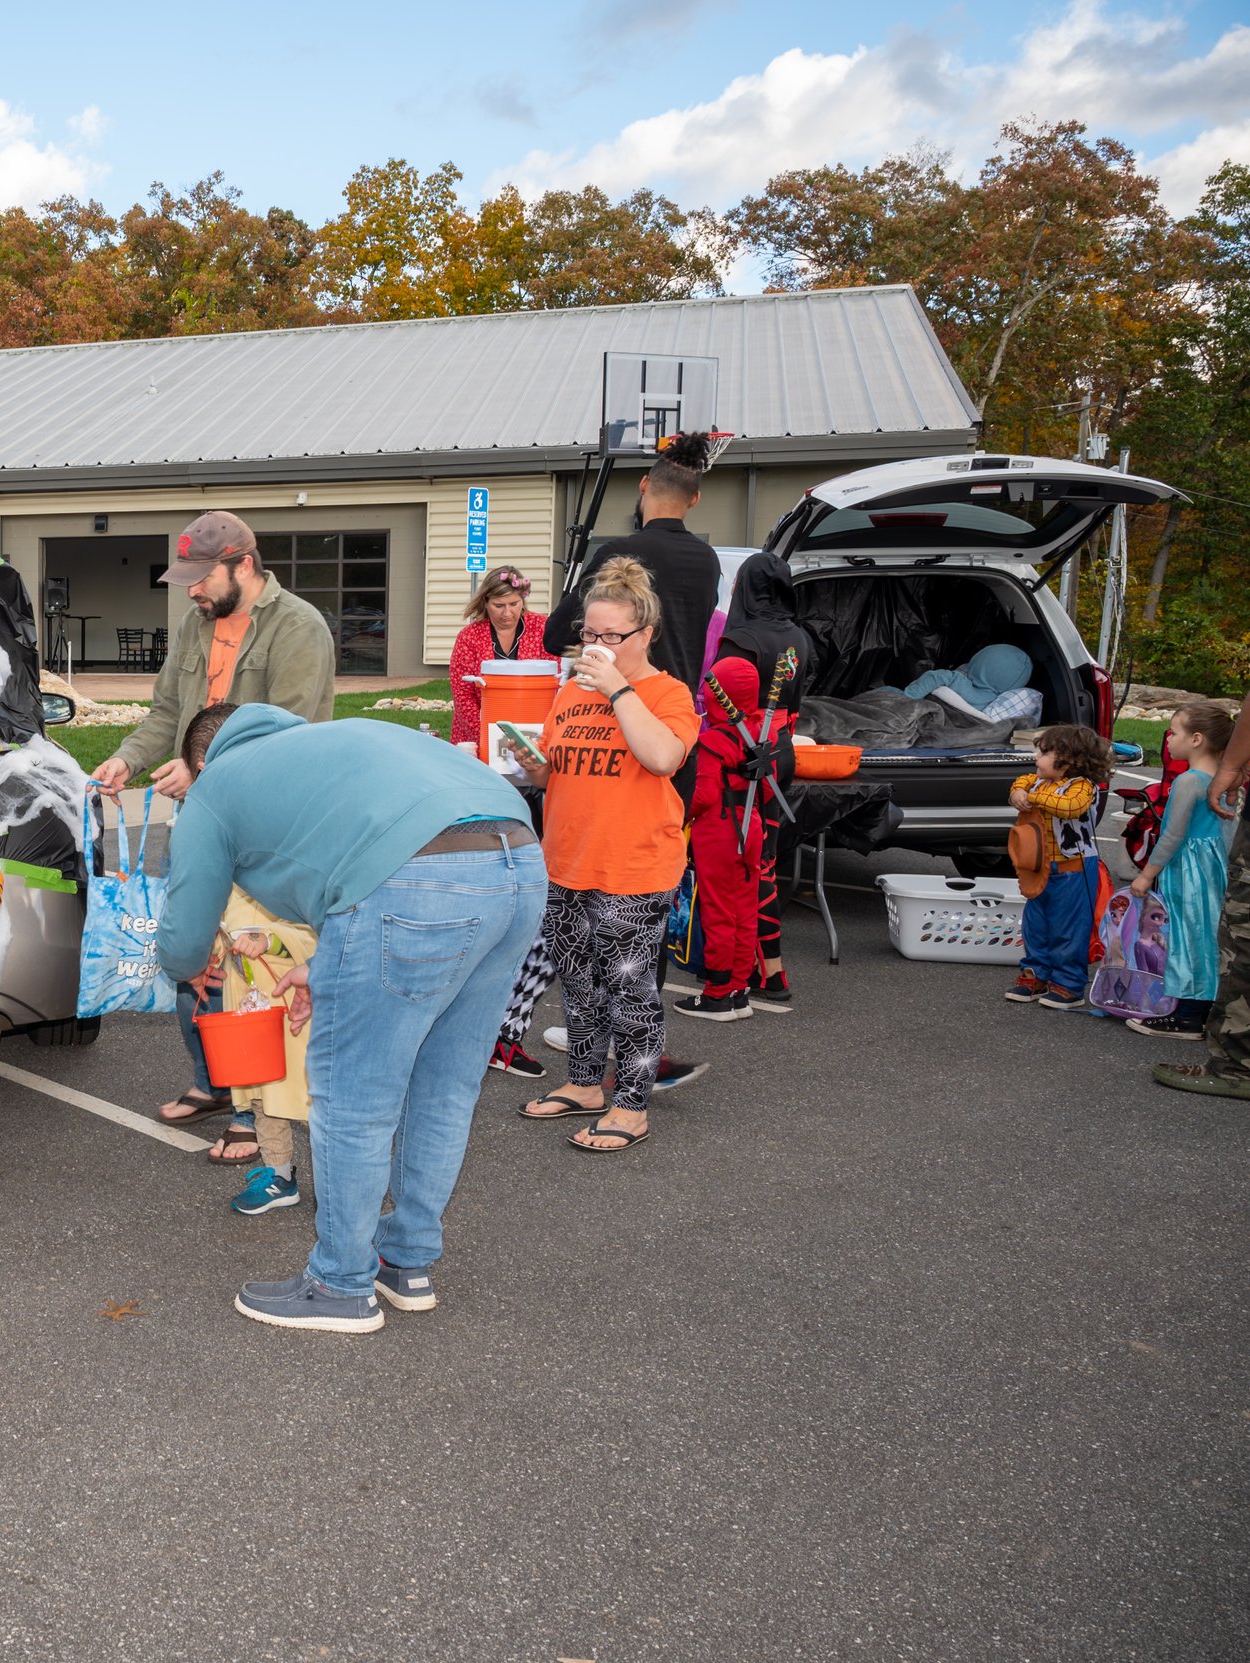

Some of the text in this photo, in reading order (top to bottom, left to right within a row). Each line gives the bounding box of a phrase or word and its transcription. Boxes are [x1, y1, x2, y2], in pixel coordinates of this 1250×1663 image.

[556, 704, 616, 725] NIGHTM
[561, 725, 617, 741] BEFORE
[121, 913, 158, 933] kee
[143, 939, 157, 957] it
